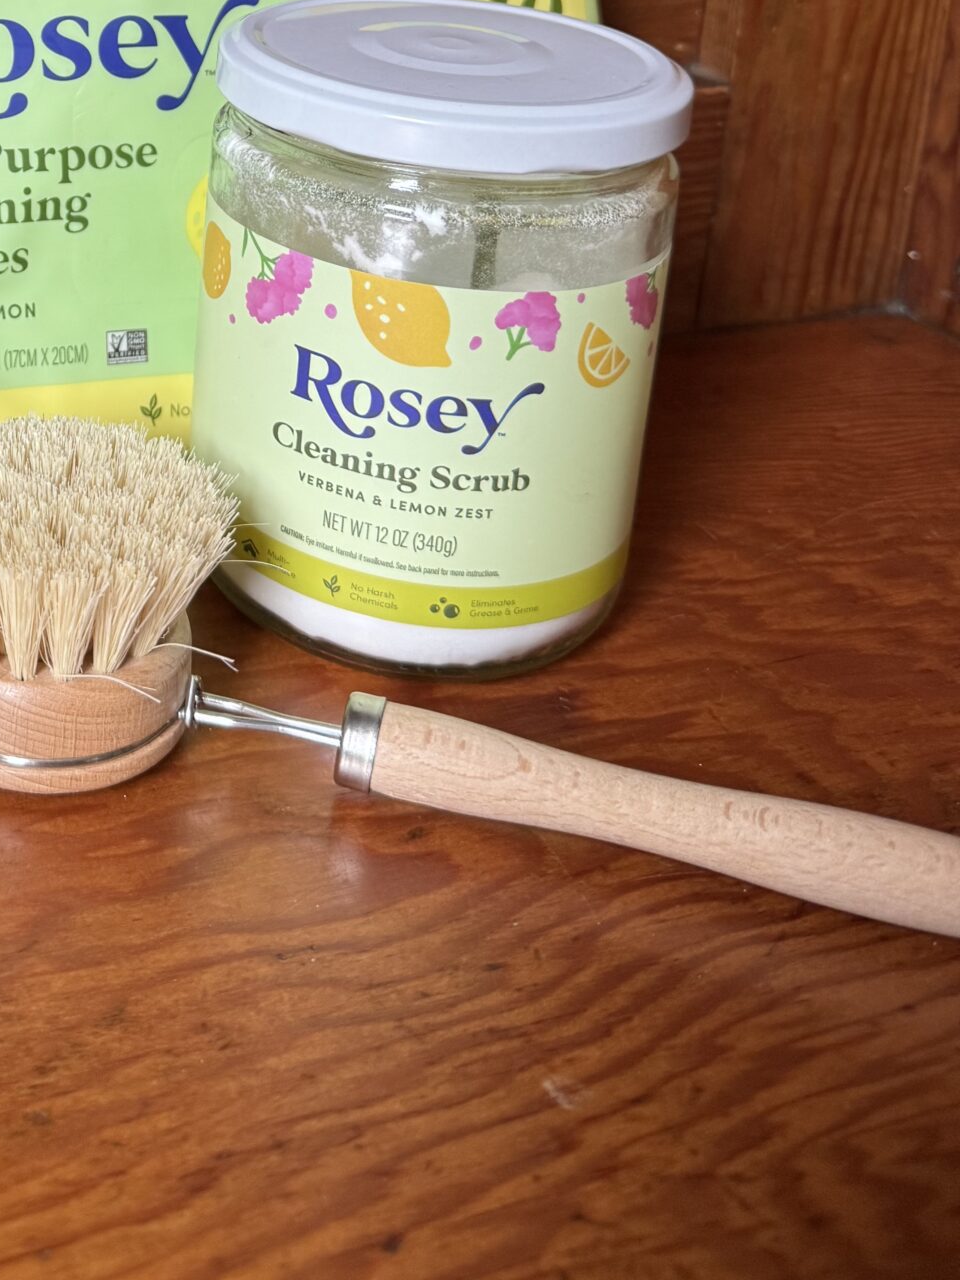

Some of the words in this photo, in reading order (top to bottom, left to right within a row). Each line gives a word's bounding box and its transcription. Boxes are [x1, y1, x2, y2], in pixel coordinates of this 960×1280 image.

[4, 348, 37, 371] (17CM
[41, 347, 49, 366] X
[52, 342, 89, 365] 20CM)
[290, 344, 545, 455] Rosey
[170, 402, 191, 417] No
[272, 421, 420, 494] Cleaning
[429, 465, 530, 492] Scrub
[298, 470, 365, 502] VERBENA
[372, 495, 382, 506] &
[390, 499, 447, 517] LEMON
[455, 507, 493, 519] ZEST
[322, 510, 347, 533] NET
[350, 517, 373, 540] WT
[375, 525, 389, 545] 12
[392, 528, 409, 548] OZ
[413, 531, 458, 558] (340g)
[423, 566, 440, 576] panel
[440, 567, 449, 576] for
[350, 582, 364, 593] No
[367, 586, 395, 599] Harsh
[350, 592, 399, 610] Chemicals
[470, 599, 516, 608] Eliminates
[469, 607, 502, 617] Grease
